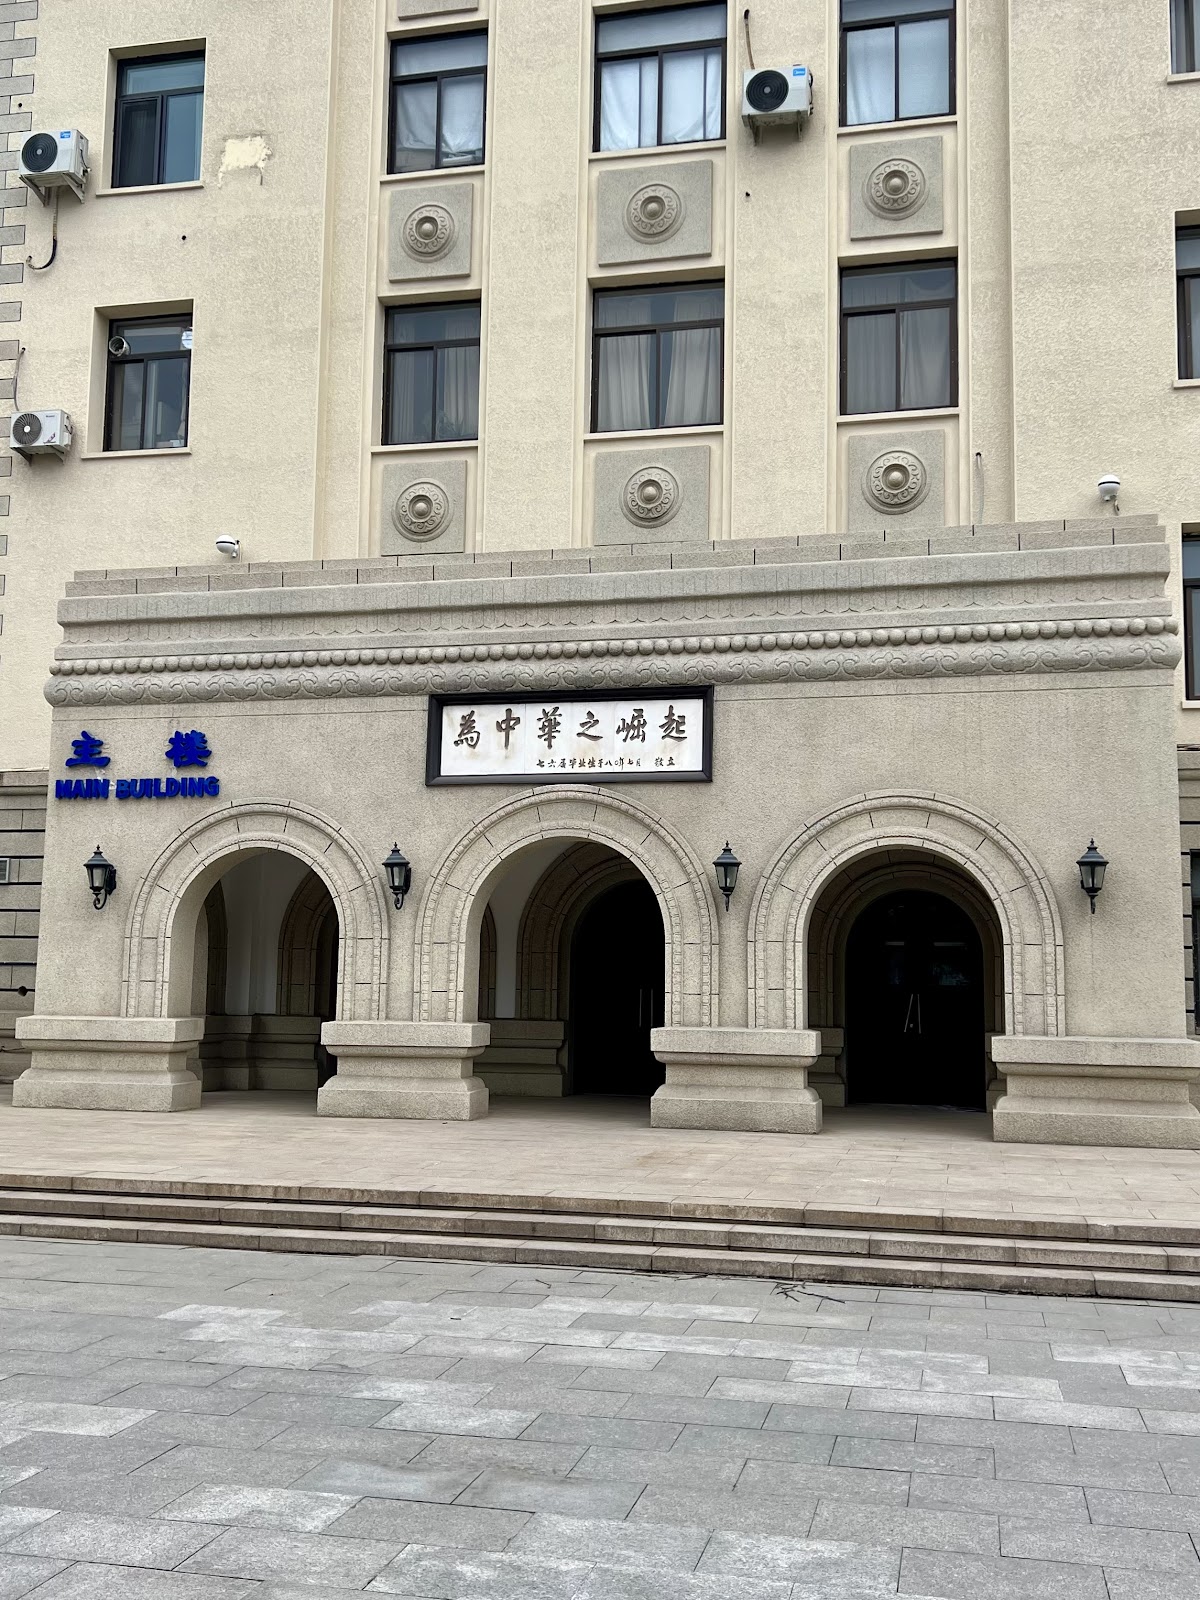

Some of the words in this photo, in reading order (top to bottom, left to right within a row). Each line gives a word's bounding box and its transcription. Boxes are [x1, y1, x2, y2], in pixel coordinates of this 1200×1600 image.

[453, 705, 688, 750] 為中華之崛起
[65, 729, 212, 768] 主楼
[55, 778, 110, 799] MAIN
[115, 776, 220, 799] BUILDING
